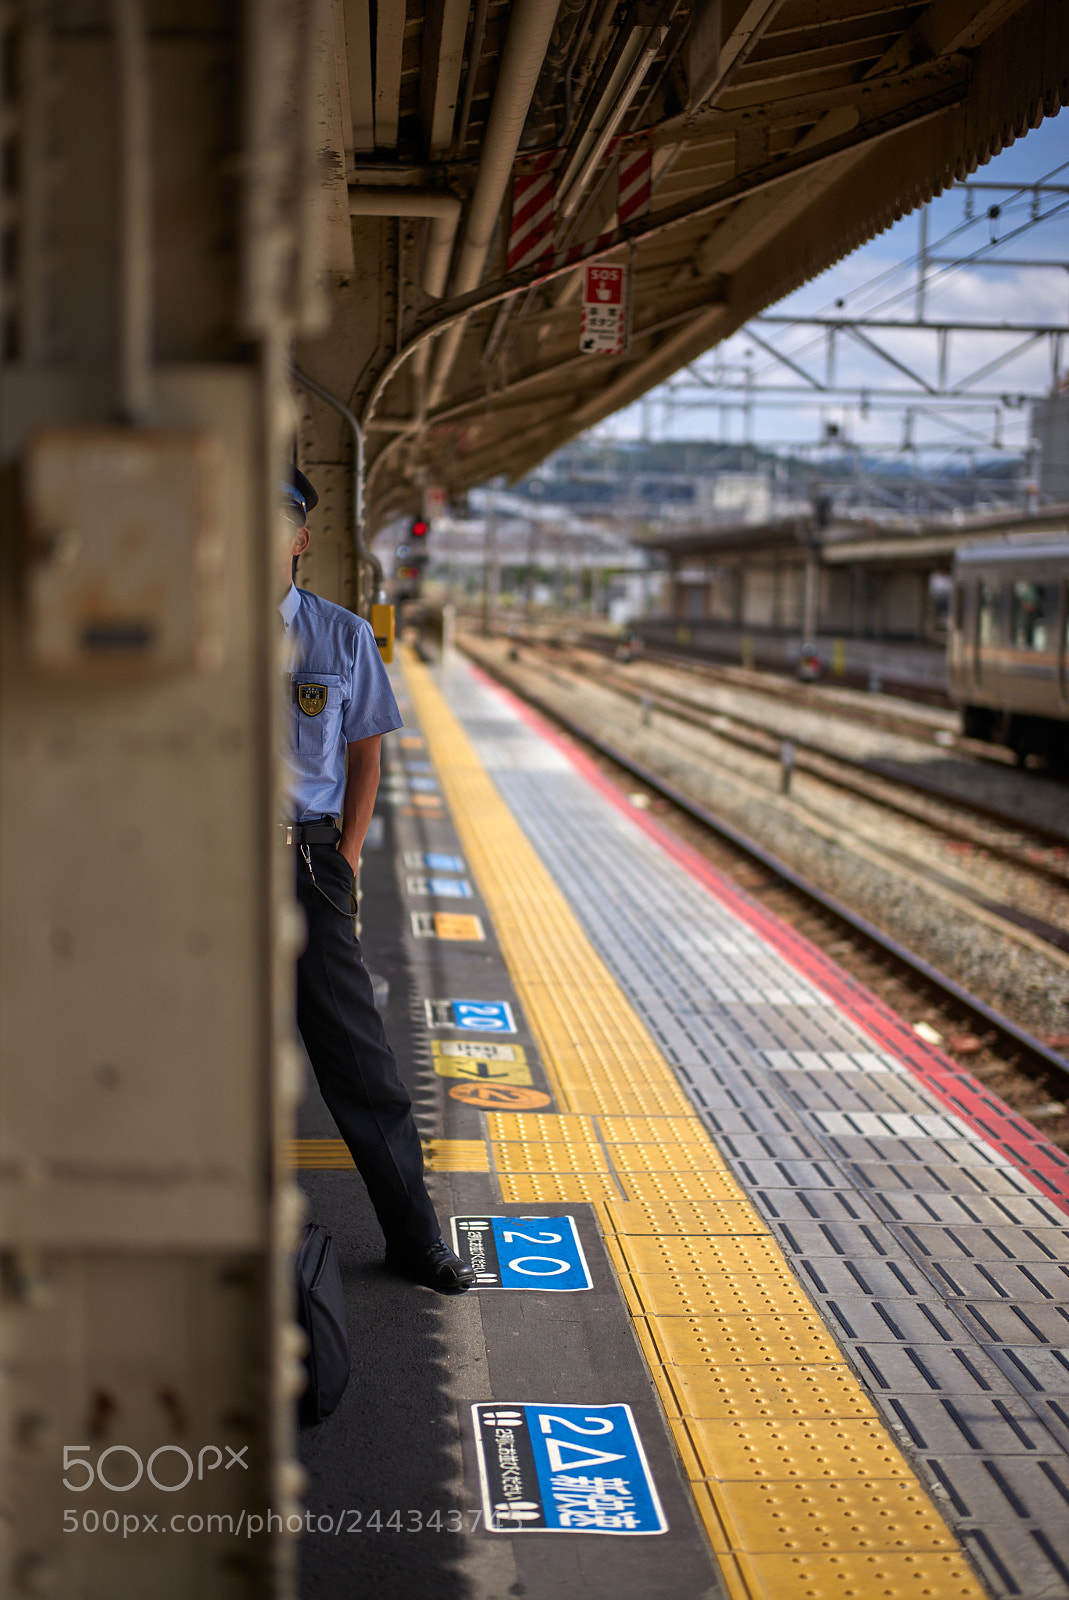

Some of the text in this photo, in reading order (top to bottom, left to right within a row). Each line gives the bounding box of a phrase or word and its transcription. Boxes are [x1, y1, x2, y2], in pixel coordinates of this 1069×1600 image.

[590, 269, 619, 280] SOS
[550, 1475, 640, 1529] 新快速
